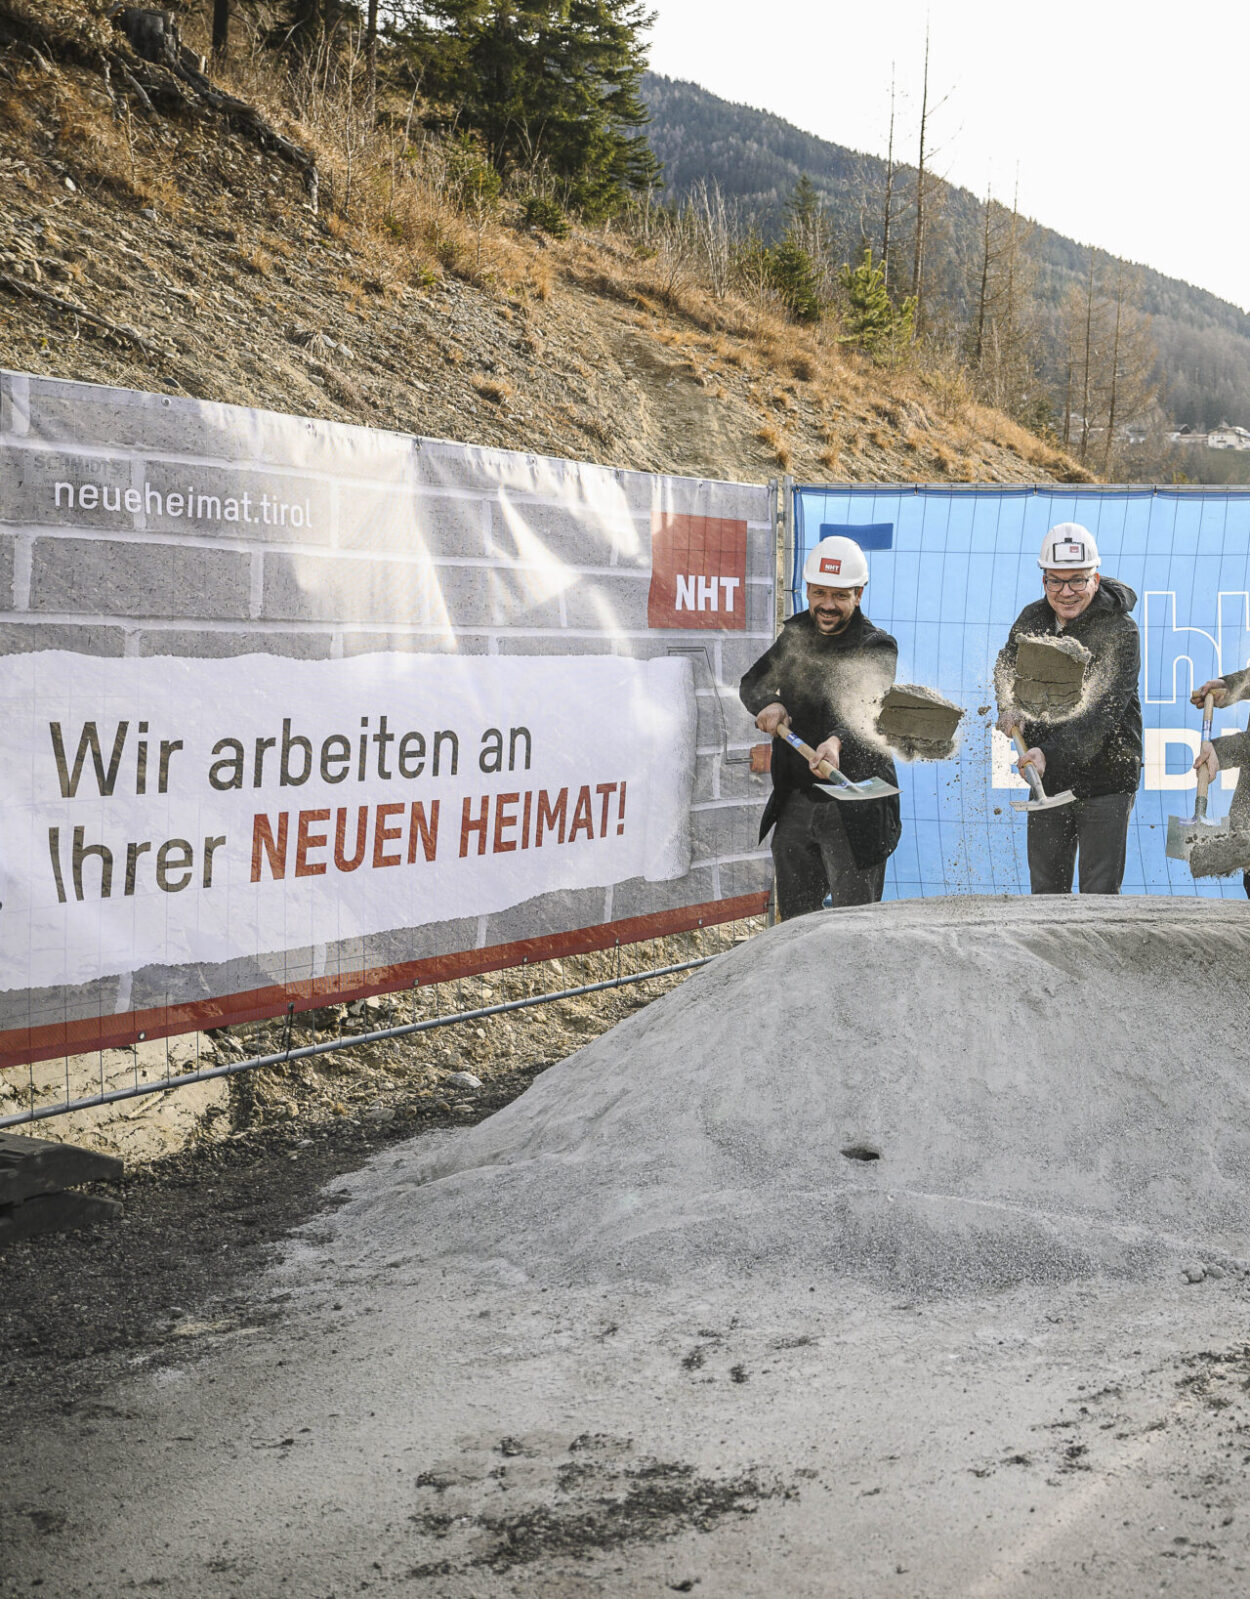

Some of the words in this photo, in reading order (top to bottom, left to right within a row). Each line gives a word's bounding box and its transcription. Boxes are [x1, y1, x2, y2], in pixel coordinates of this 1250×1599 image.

[54, 481, 312, 528] neueheimat.tirol
[824, 563, 840, 571] NHT
[675, 573, 740, 613] NHT
[49, 721, 184, 799] Wir
[209, 716, 459, 792] arbeiten
[479, 726, 532, 774] an
[49, 826, 227, 904] Ihrer
[252, 800, 440, 882] NEUEN
[460, 781, 627, 857] HEIMAT!
